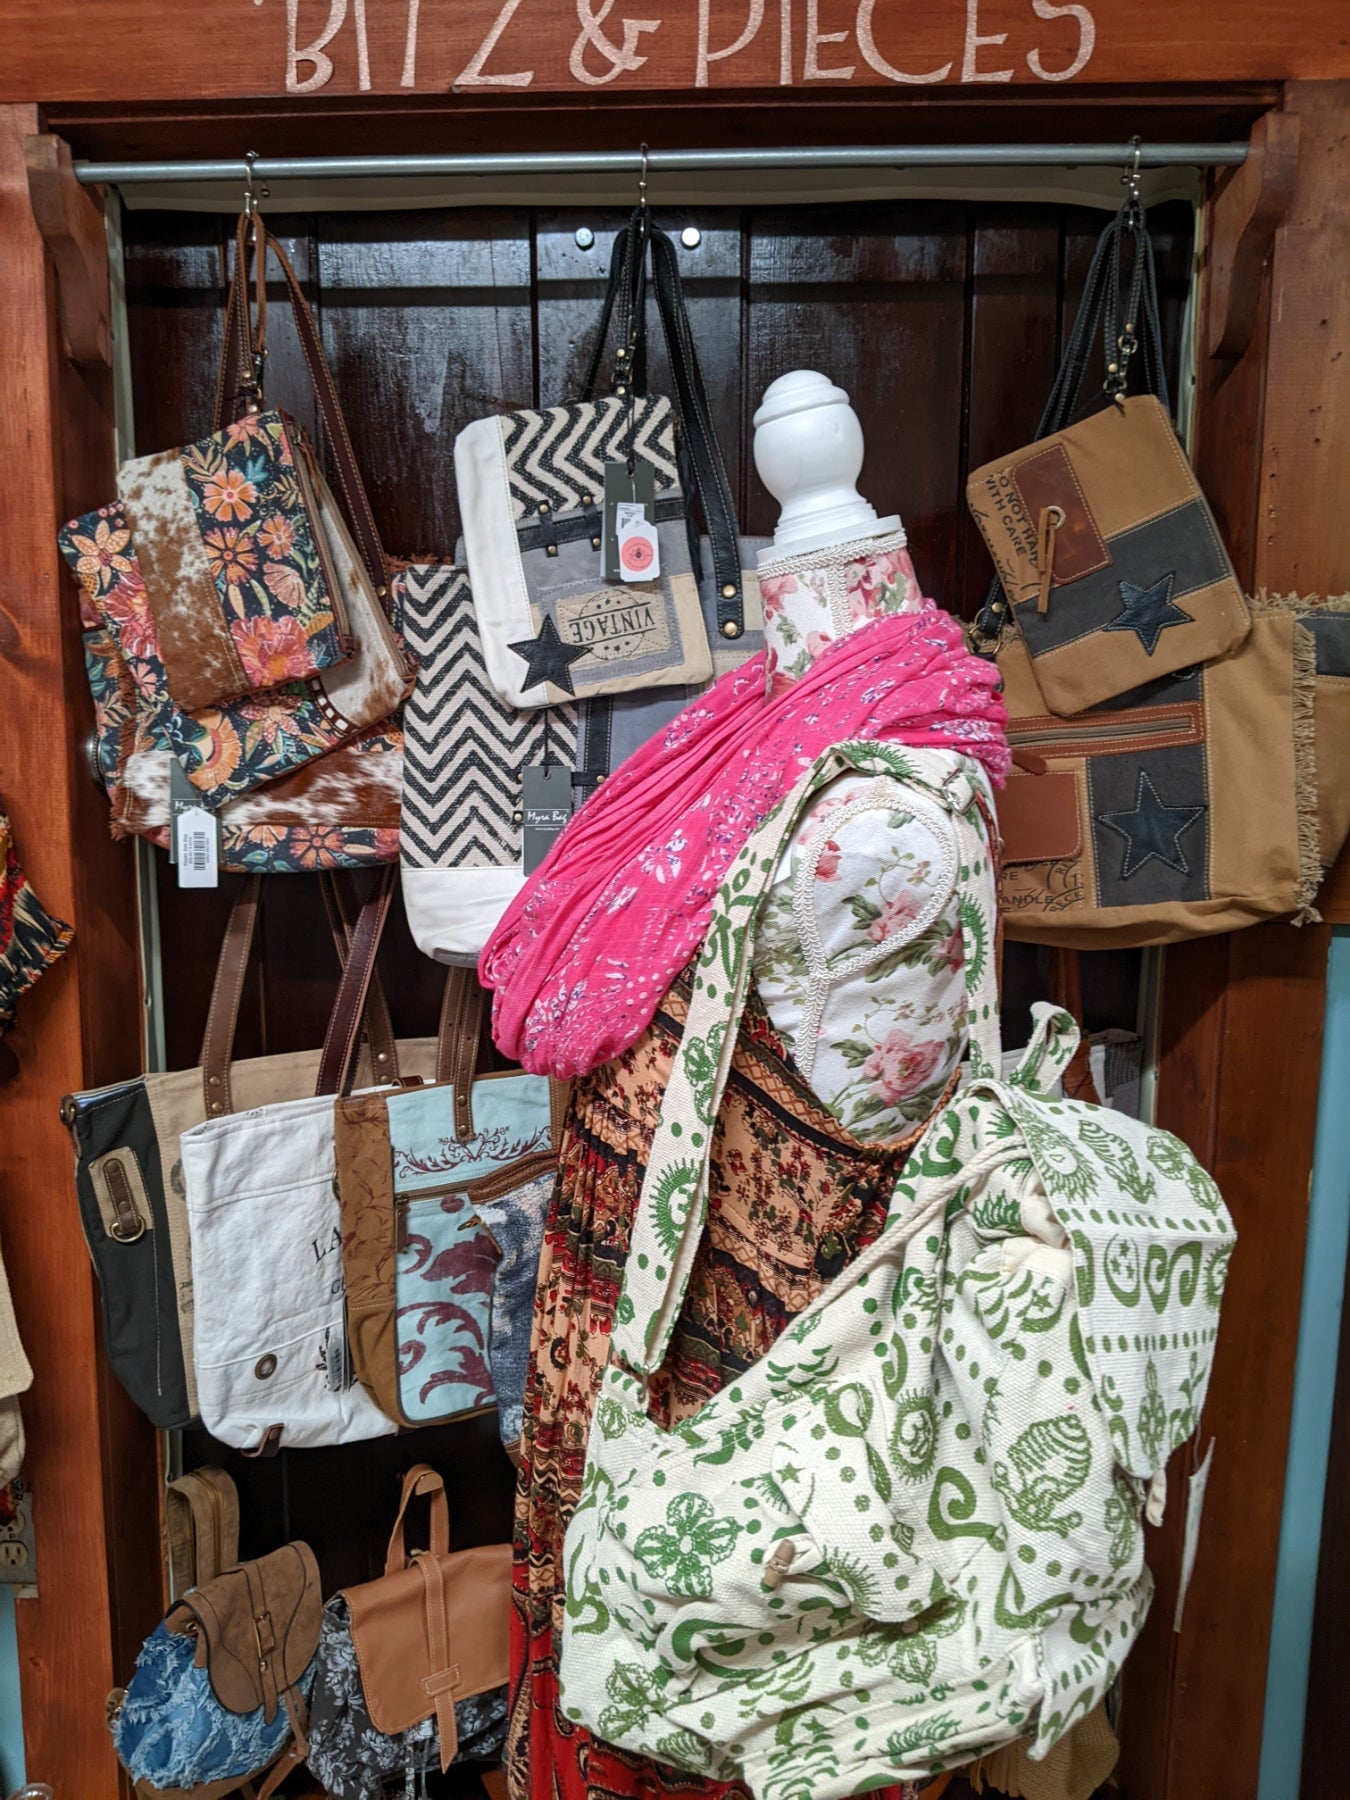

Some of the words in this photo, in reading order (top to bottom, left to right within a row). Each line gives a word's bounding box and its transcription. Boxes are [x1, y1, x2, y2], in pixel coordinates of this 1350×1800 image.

[569, 0, 662, 85] &
[695, 0, 1096, 87] PIECES
[1006, 492, 1026, 523] NOT
[1002, 515, 1027, 557] CARE
[569, 607, 655, 643] VINTAGE
[527, 811, 551, 824] Myra
[552, 811, 567, 824] Bag
[1001, 895, 1053, 906] ANDLE
